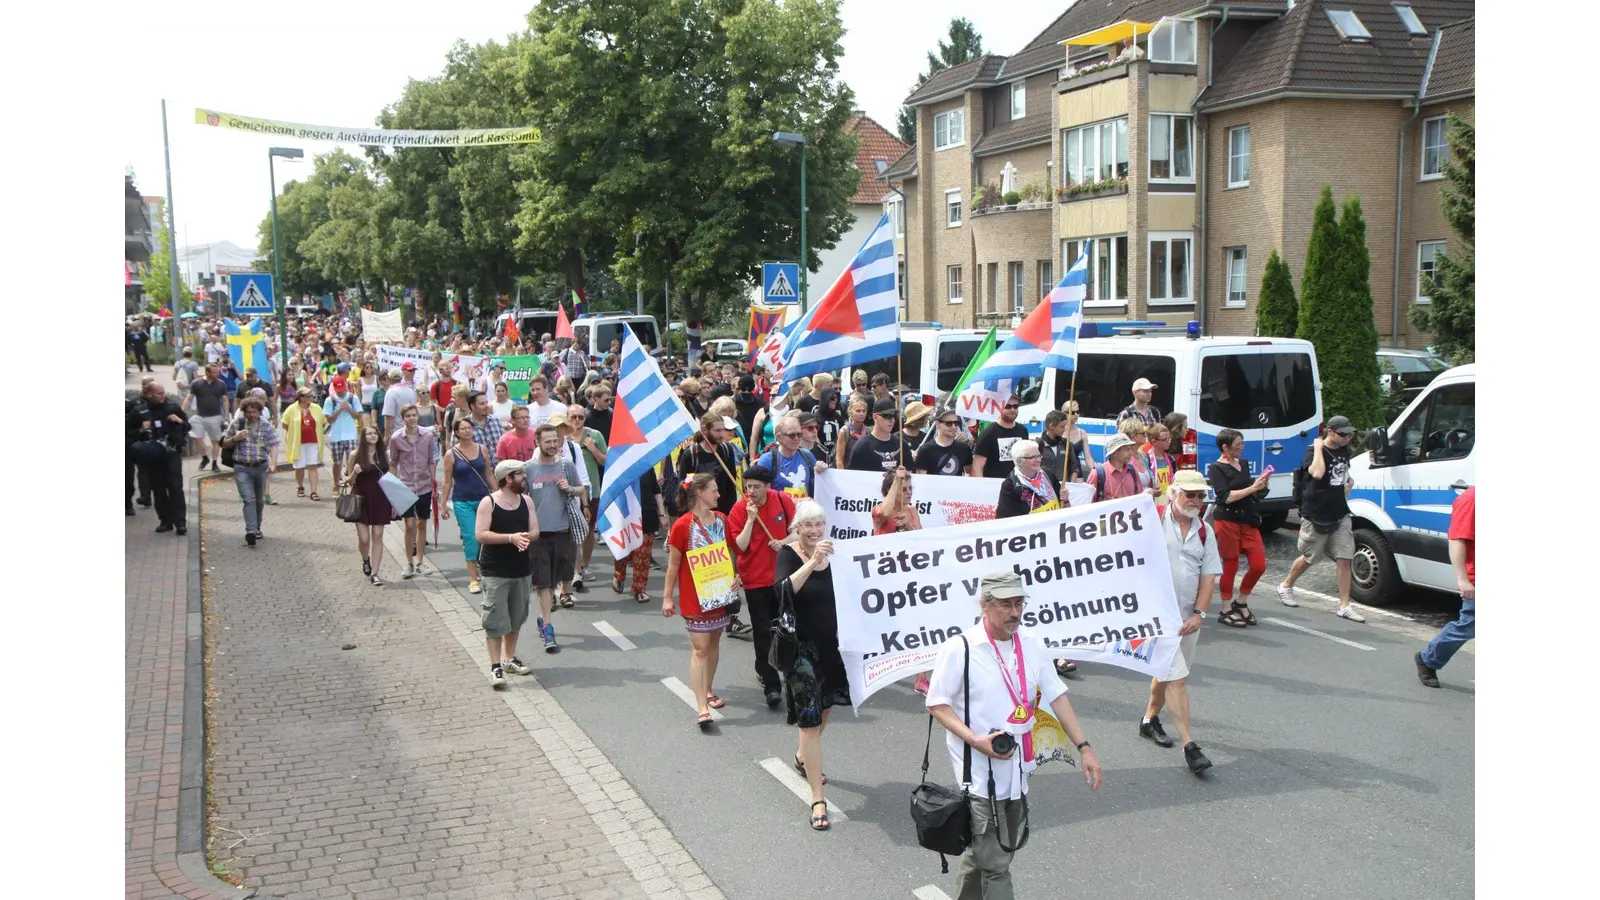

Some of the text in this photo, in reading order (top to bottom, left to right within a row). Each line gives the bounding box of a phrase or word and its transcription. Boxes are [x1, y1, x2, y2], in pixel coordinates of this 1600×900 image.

[228, 118, 541, 146] Gemeinsam gegen Ausländerfeindlichkeit und Rassismus
[961, 394, 1006, 415] VVN
[834, 496, 899, 514] Faschi
[915, 499, 933, 515] ist
[829, 525, 868, 541] keine
[852, 507, 1143, 579] Täter ehren heißt
[688, 546, 729, 571] PMK
[860, 549, 1145, 617] Opfer vhöhnen.
[881, 592, 1139, 654] Keine söhnung
[1043, 617, 1164, 648] brechen!
[868, 664, 894, 680] Bund
